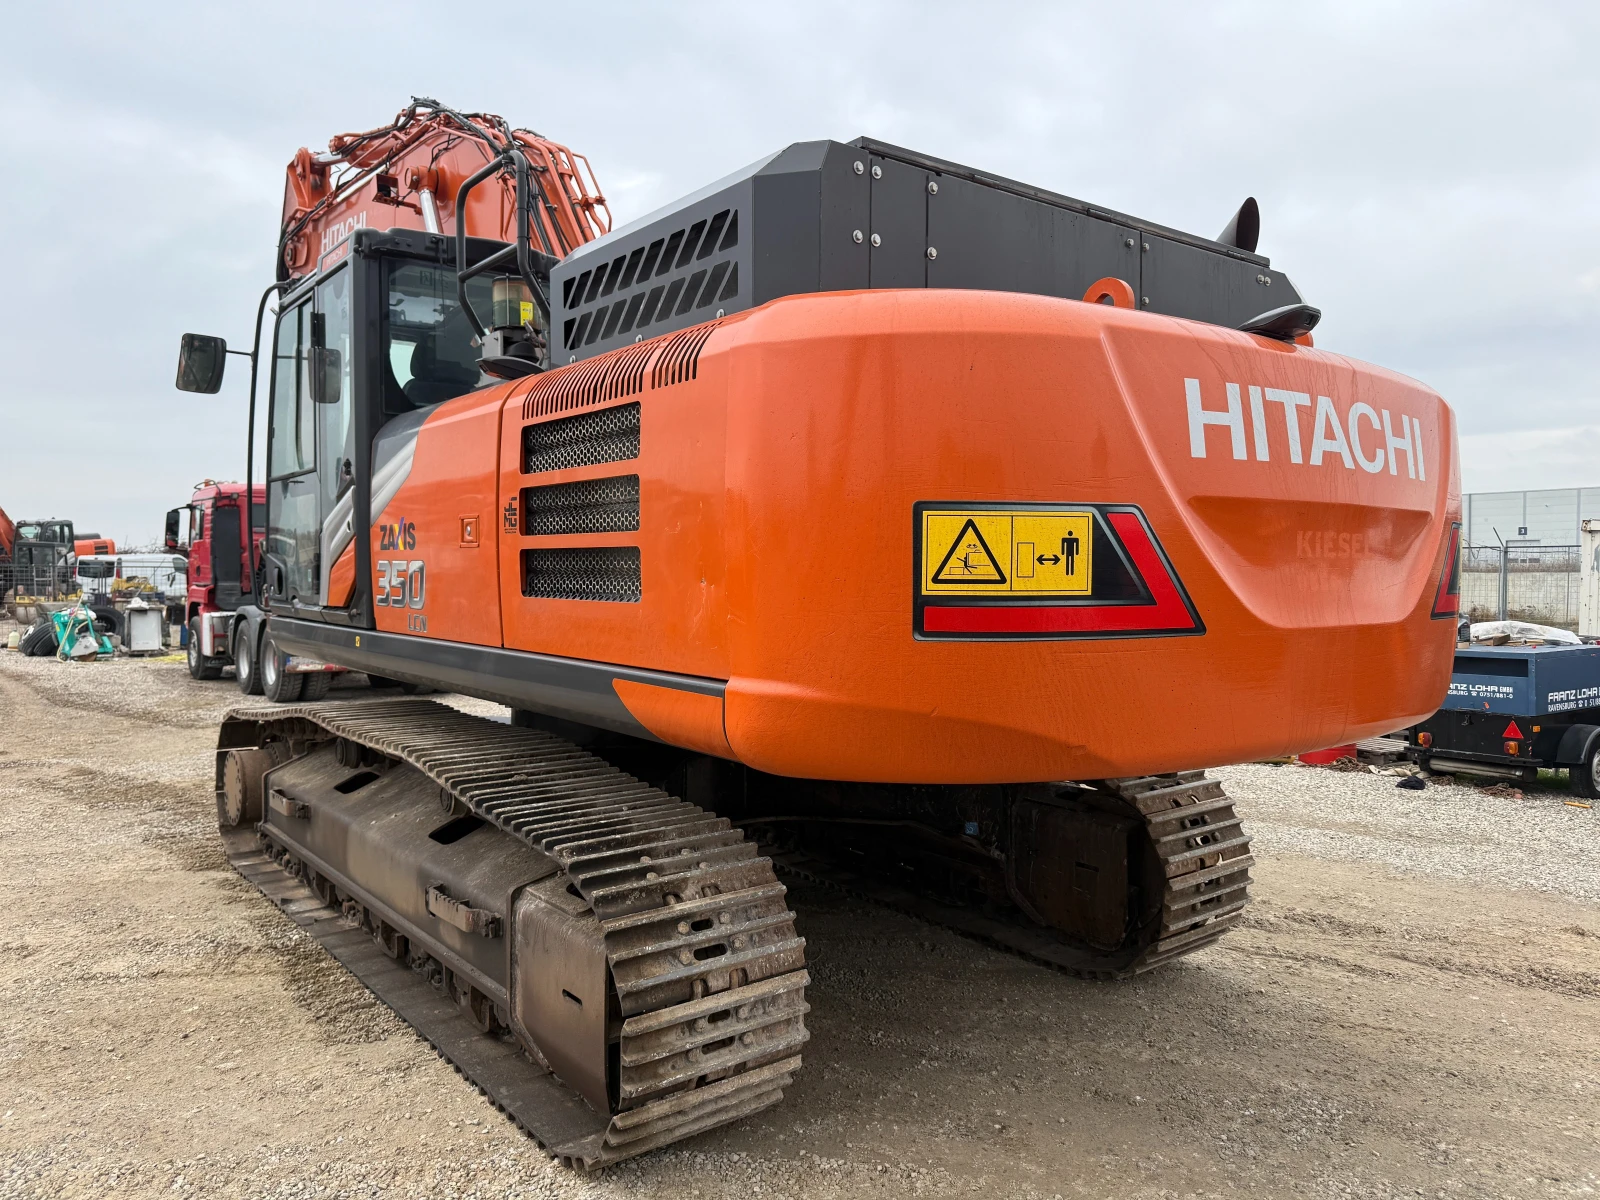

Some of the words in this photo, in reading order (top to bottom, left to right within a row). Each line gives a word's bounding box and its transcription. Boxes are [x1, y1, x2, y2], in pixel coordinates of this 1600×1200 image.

[321, 211, 366, 254] HITACHI
[1184, 377, 1425, 481] HITACHI
[380, 517, 416, 550] ZAXIS
[1296, 530, 1376, 559] KIESEL
[376, 560, 426, 610] 350
[408, 613, 428, 633] LCN
[1469, 684, 1498, 692] LOHR
[1548, 690, 1576, 702] FRANZ
[1577, 687, 1598, 699] LOHR
[1548, 701, 1577, 712] RAVENSBURG
